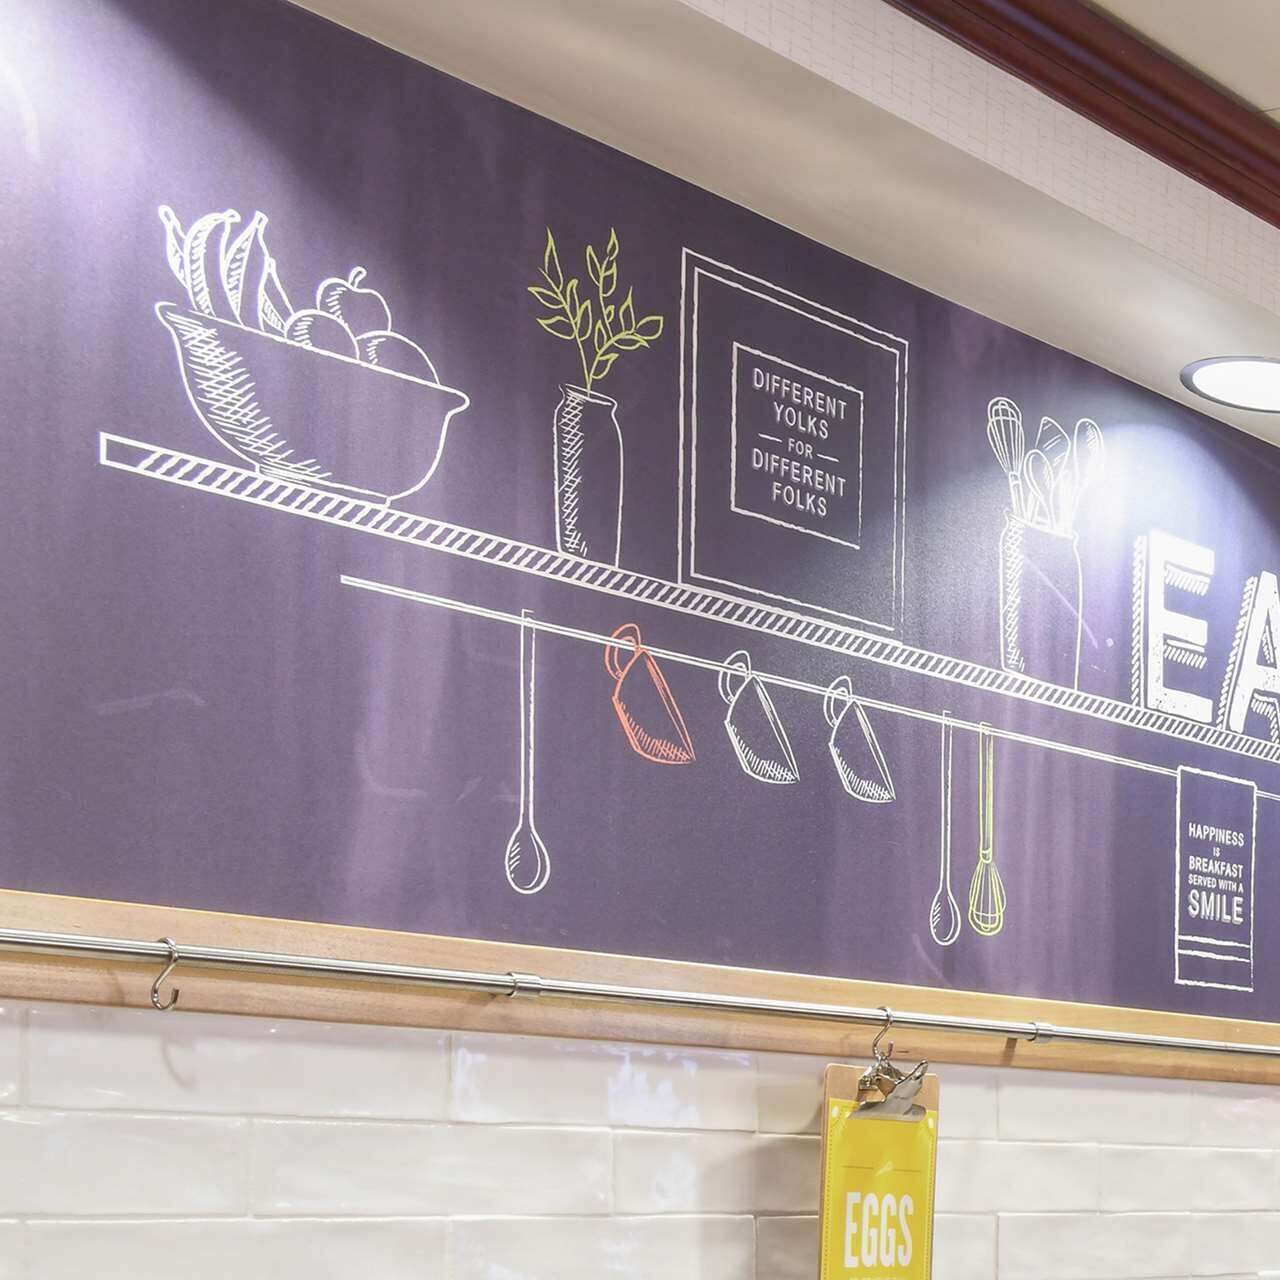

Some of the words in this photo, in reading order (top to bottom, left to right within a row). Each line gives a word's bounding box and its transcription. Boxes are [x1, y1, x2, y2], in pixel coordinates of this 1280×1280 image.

[752, 367, 847, 420] DIFFERENT
[773, 402, 829, 440] YOLKS
[788, 438, 813, 460] FOR
[752, 448, 846, 498] DIFFERENT
[772, 482, 828, 517] FOLKS
[1188, 822, 1245, 847] HAPPINESS
[1213, 847, 1220, 857] IS
[1188, 856, 1244, 879] BREAKFAST
[1188, 873, 1217, 889] SERVED
[1218, 879, 1238, 893] WITH
[1238, 882, 1244, 894] A
[1188, 889, 1244, 925] SMILE
[843, 1191, 914, 1269] EGGS
